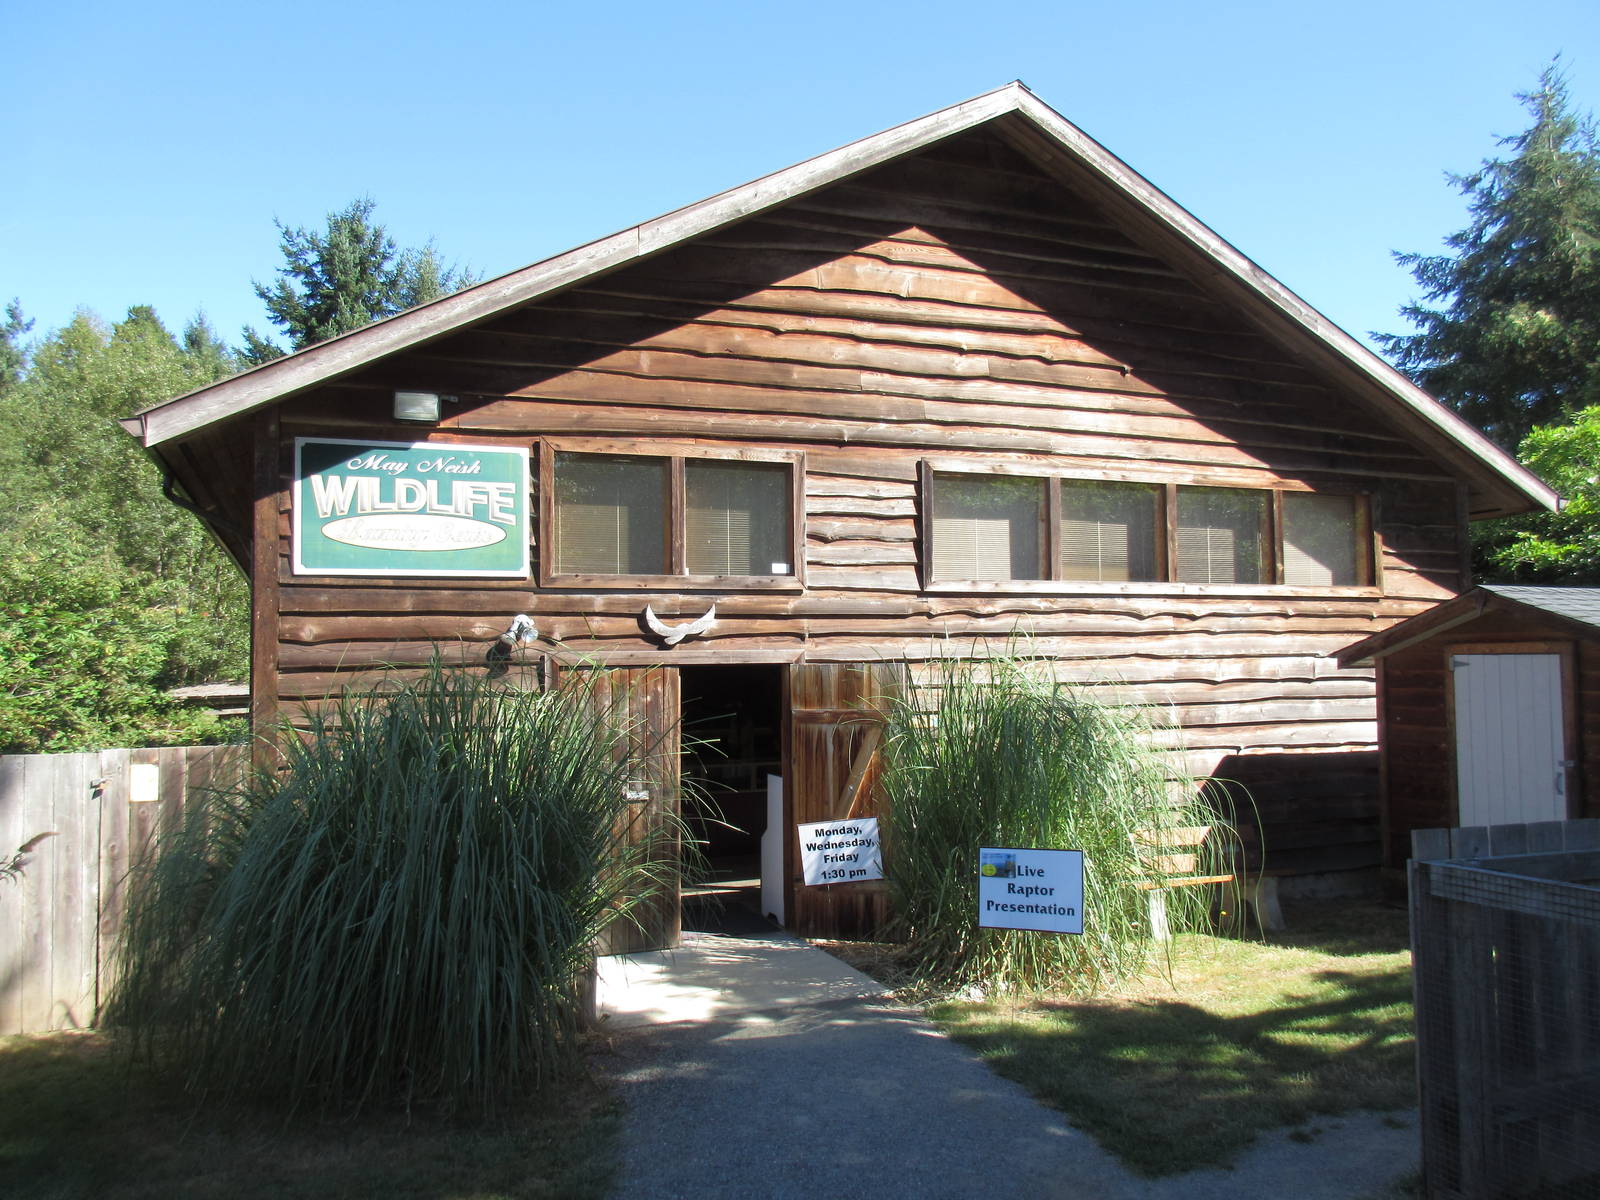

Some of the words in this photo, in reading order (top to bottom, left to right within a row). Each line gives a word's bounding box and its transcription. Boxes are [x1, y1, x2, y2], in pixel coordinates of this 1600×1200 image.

[347, 454, 409, 475] May
[417, 456, 480, 474] Neish
[310, 474, 516, 526] WILDLIFE
[815, 826, 862, 837] Monday,
[806, 838, 874, 851] Wednesday,
[824, 853, 859, 863] Friday
[821, 869, 845, 879] 1:30
[849, 868, 866, 879] pm
[1017, 865, 1045, 877] Live
[1007, 882, 1054, 897] Raptor
[986, 900, 1075, 916] Presentation
